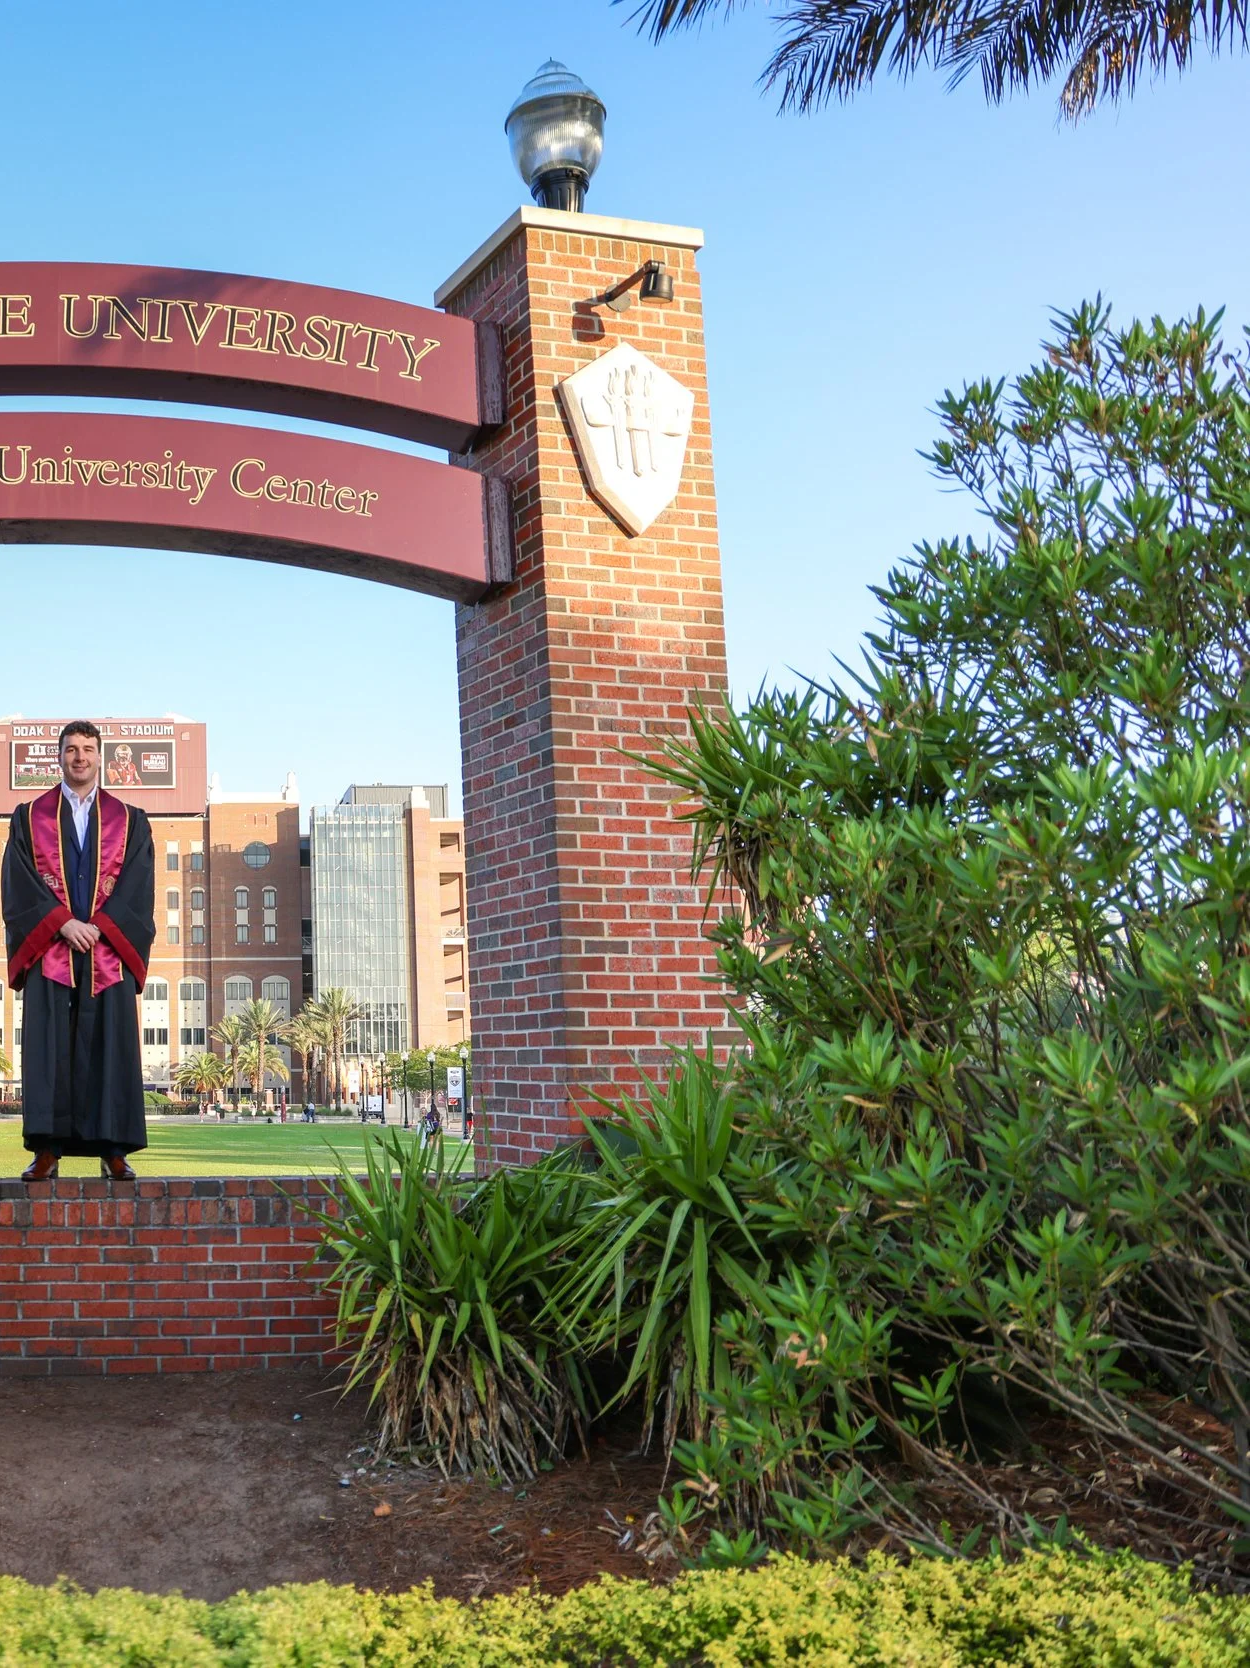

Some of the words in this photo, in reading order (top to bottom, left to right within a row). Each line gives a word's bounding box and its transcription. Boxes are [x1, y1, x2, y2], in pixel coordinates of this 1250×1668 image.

[58, 293, 441, 382] UNIVERSITY
[230, 457, 379, 518] Center
[12, 725, 45, 737] DOAK
[120, 725, 174, 736] STADIUM
